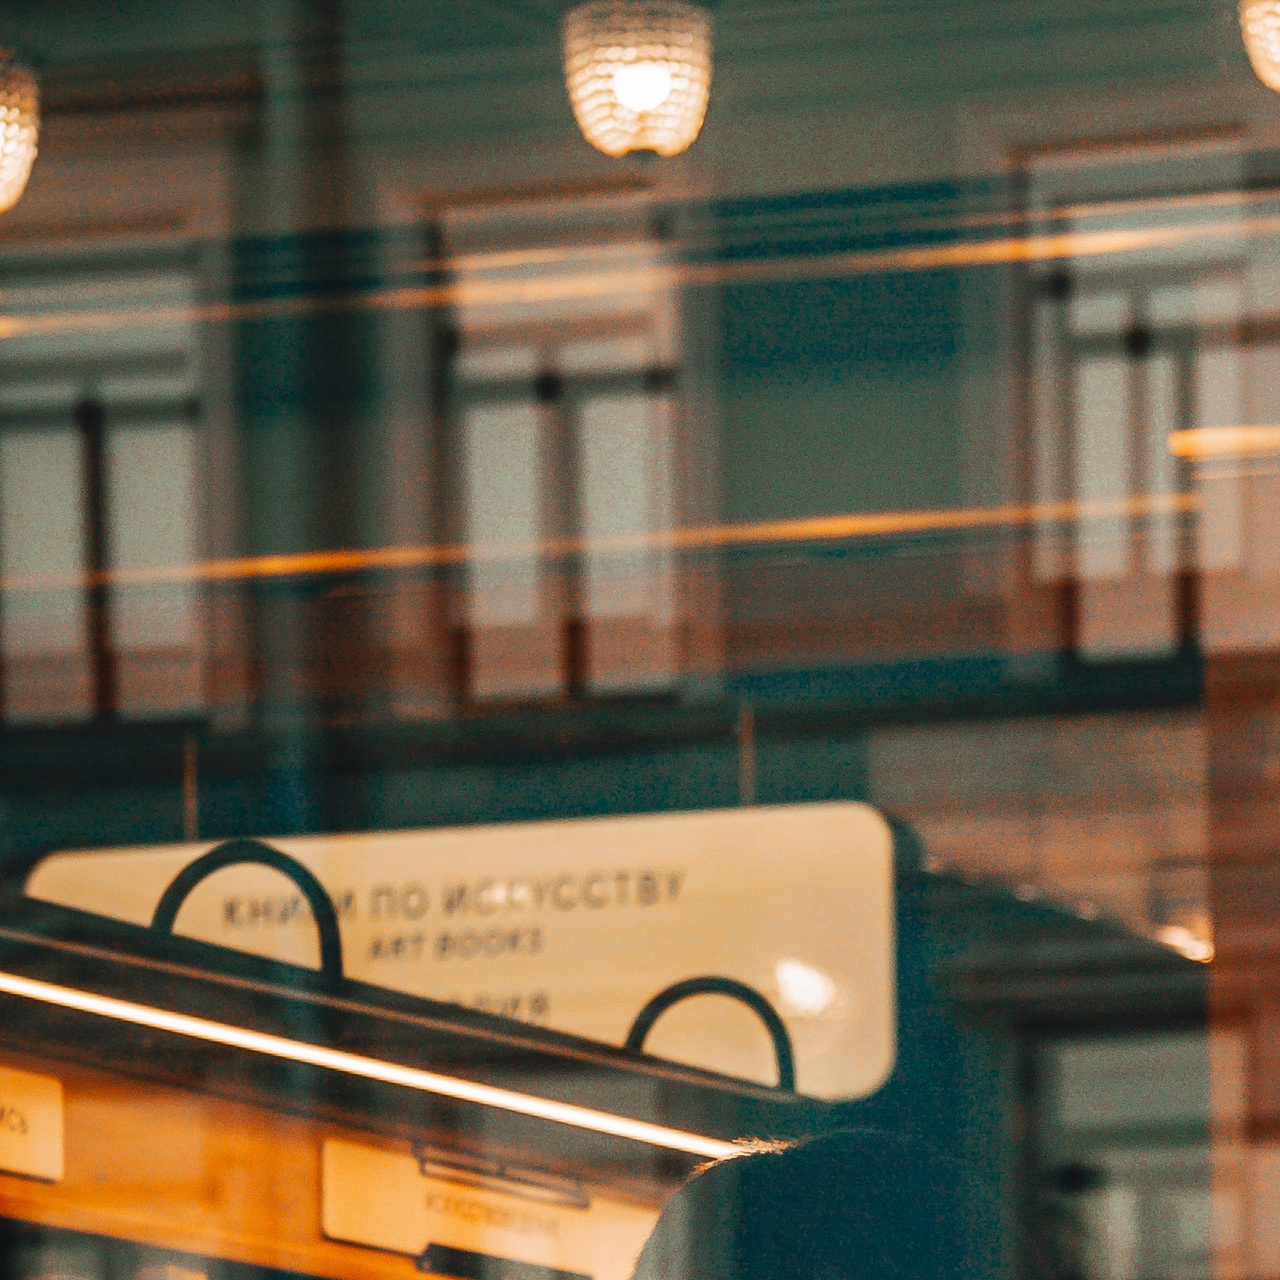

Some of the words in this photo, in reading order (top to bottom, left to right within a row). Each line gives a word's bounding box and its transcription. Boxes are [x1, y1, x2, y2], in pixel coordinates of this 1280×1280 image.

[222, 888, 357, 927] КНИИ
[371, 882, 429, 921] ПО
[368, 931, 423, 962] ART
[434, 927, 545, 961] BOOKS
